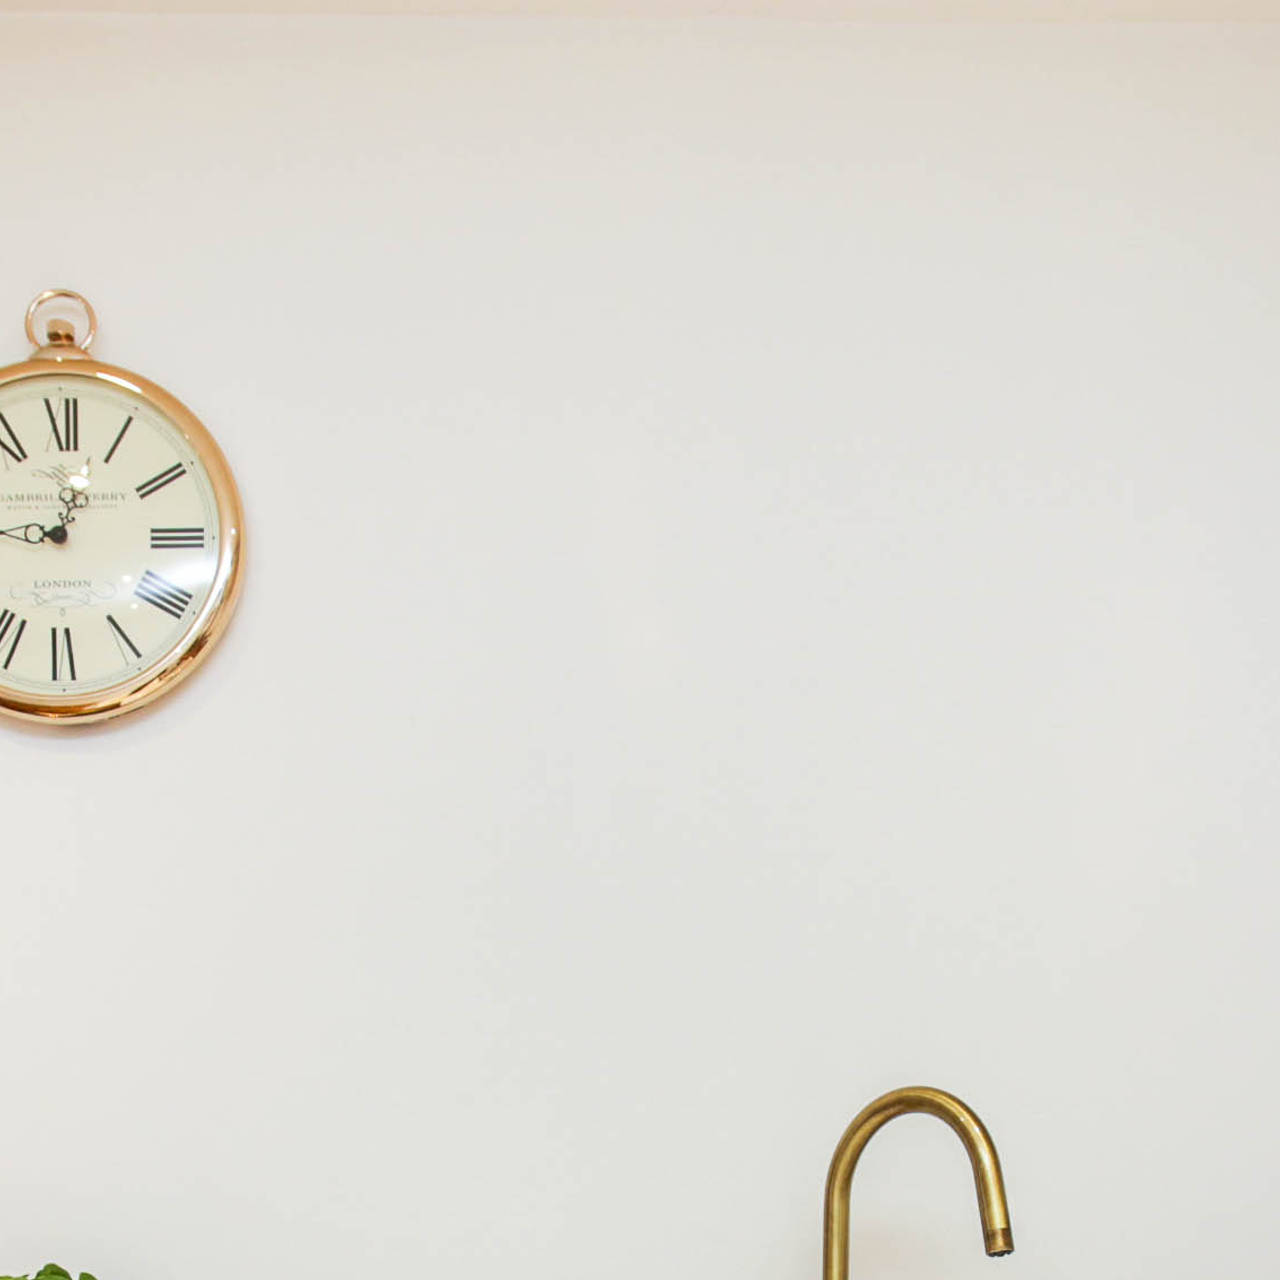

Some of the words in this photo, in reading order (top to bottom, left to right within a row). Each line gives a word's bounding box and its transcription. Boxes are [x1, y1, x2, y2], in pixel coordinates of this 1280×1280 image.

[42, 398, 78, 451] XII
[104, 416, 133, 464] I
[136, 462, 187, 499] II
[150, 528, 205, 549] III
[33, 579, 91, 589] LONDON
[51, 627, 77, 681] VI
[106, 614, 142, 667] V
